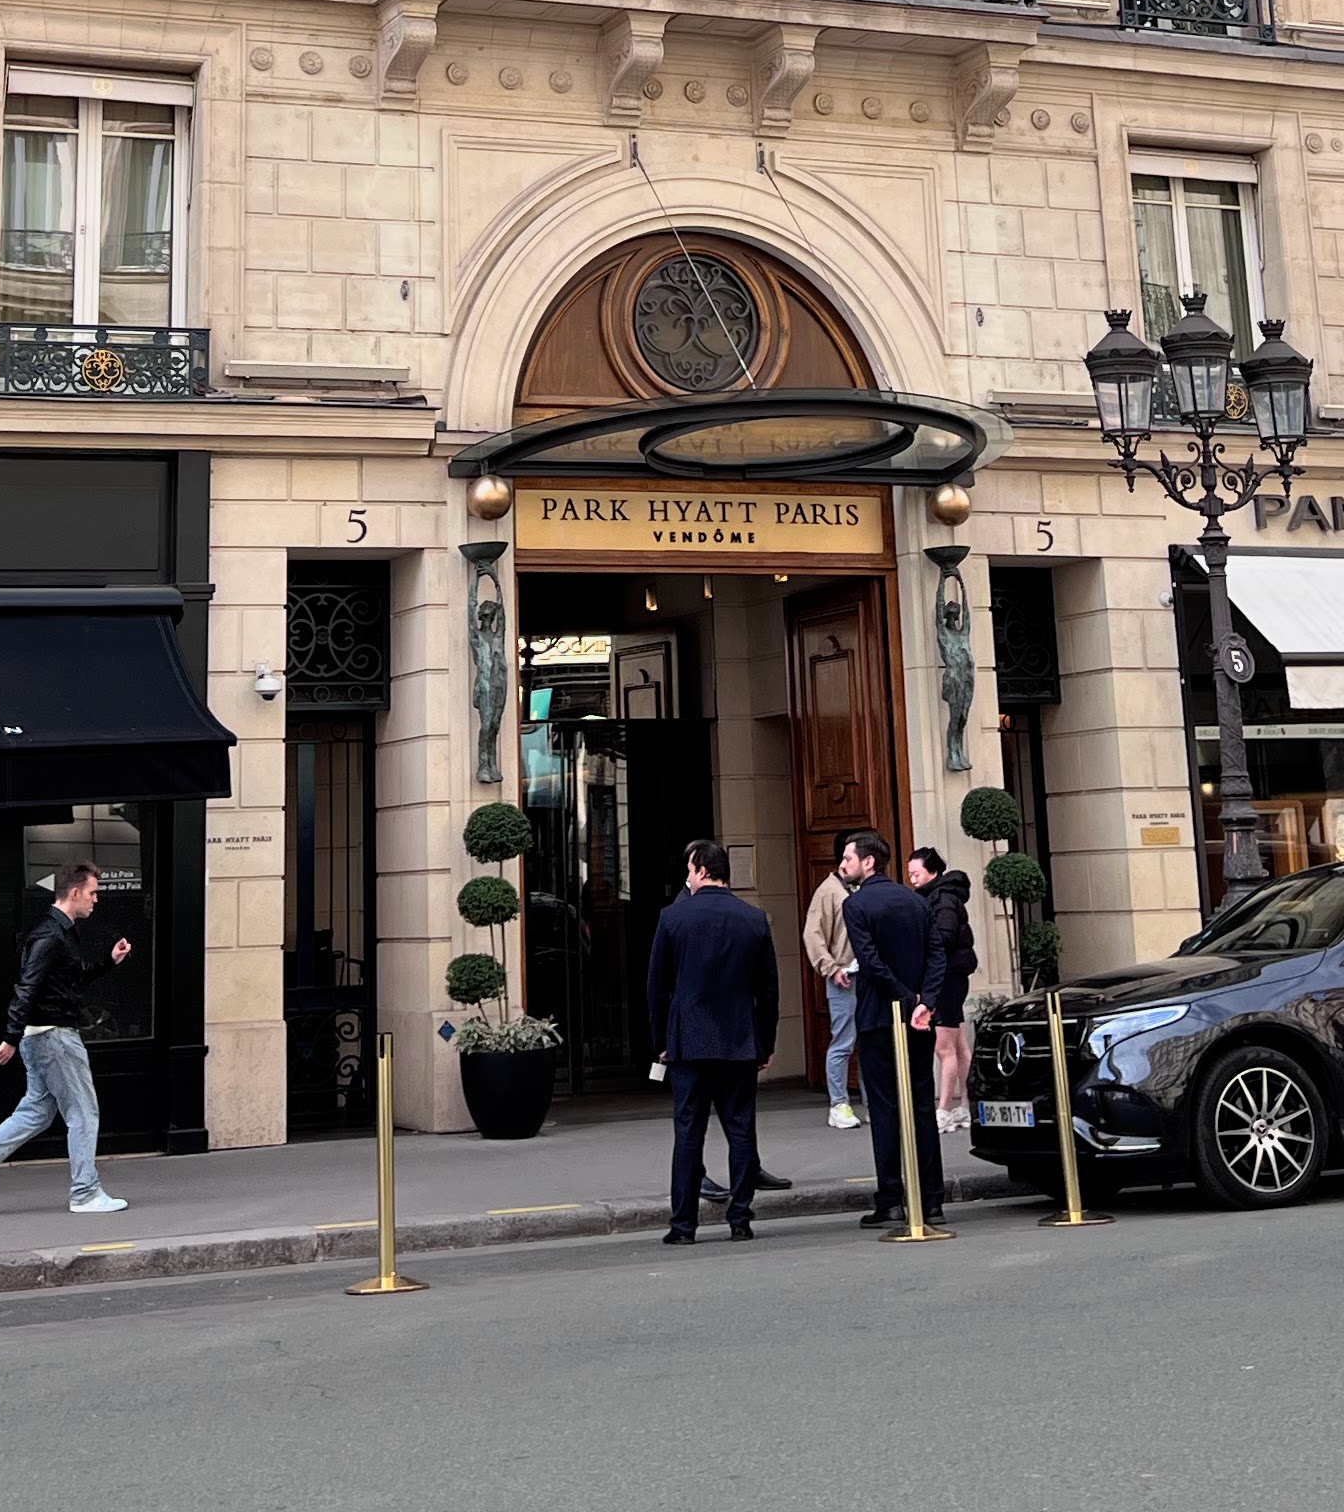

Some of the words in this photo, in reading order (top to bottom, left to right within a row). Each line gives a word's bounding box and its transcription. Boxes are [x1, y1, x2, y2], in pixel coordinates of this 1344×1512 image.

[346, 509, 367, 543] 5
[541, 497, 631, 522] PARK
[648, 499, 757, 524] HYATT
[775, 502, 860, 526] PARIS
[653, 528, 755, 544] VENDÔME
[1036, 520, 1053, 552] 5
[1230, 650, 1244, 673] 5
